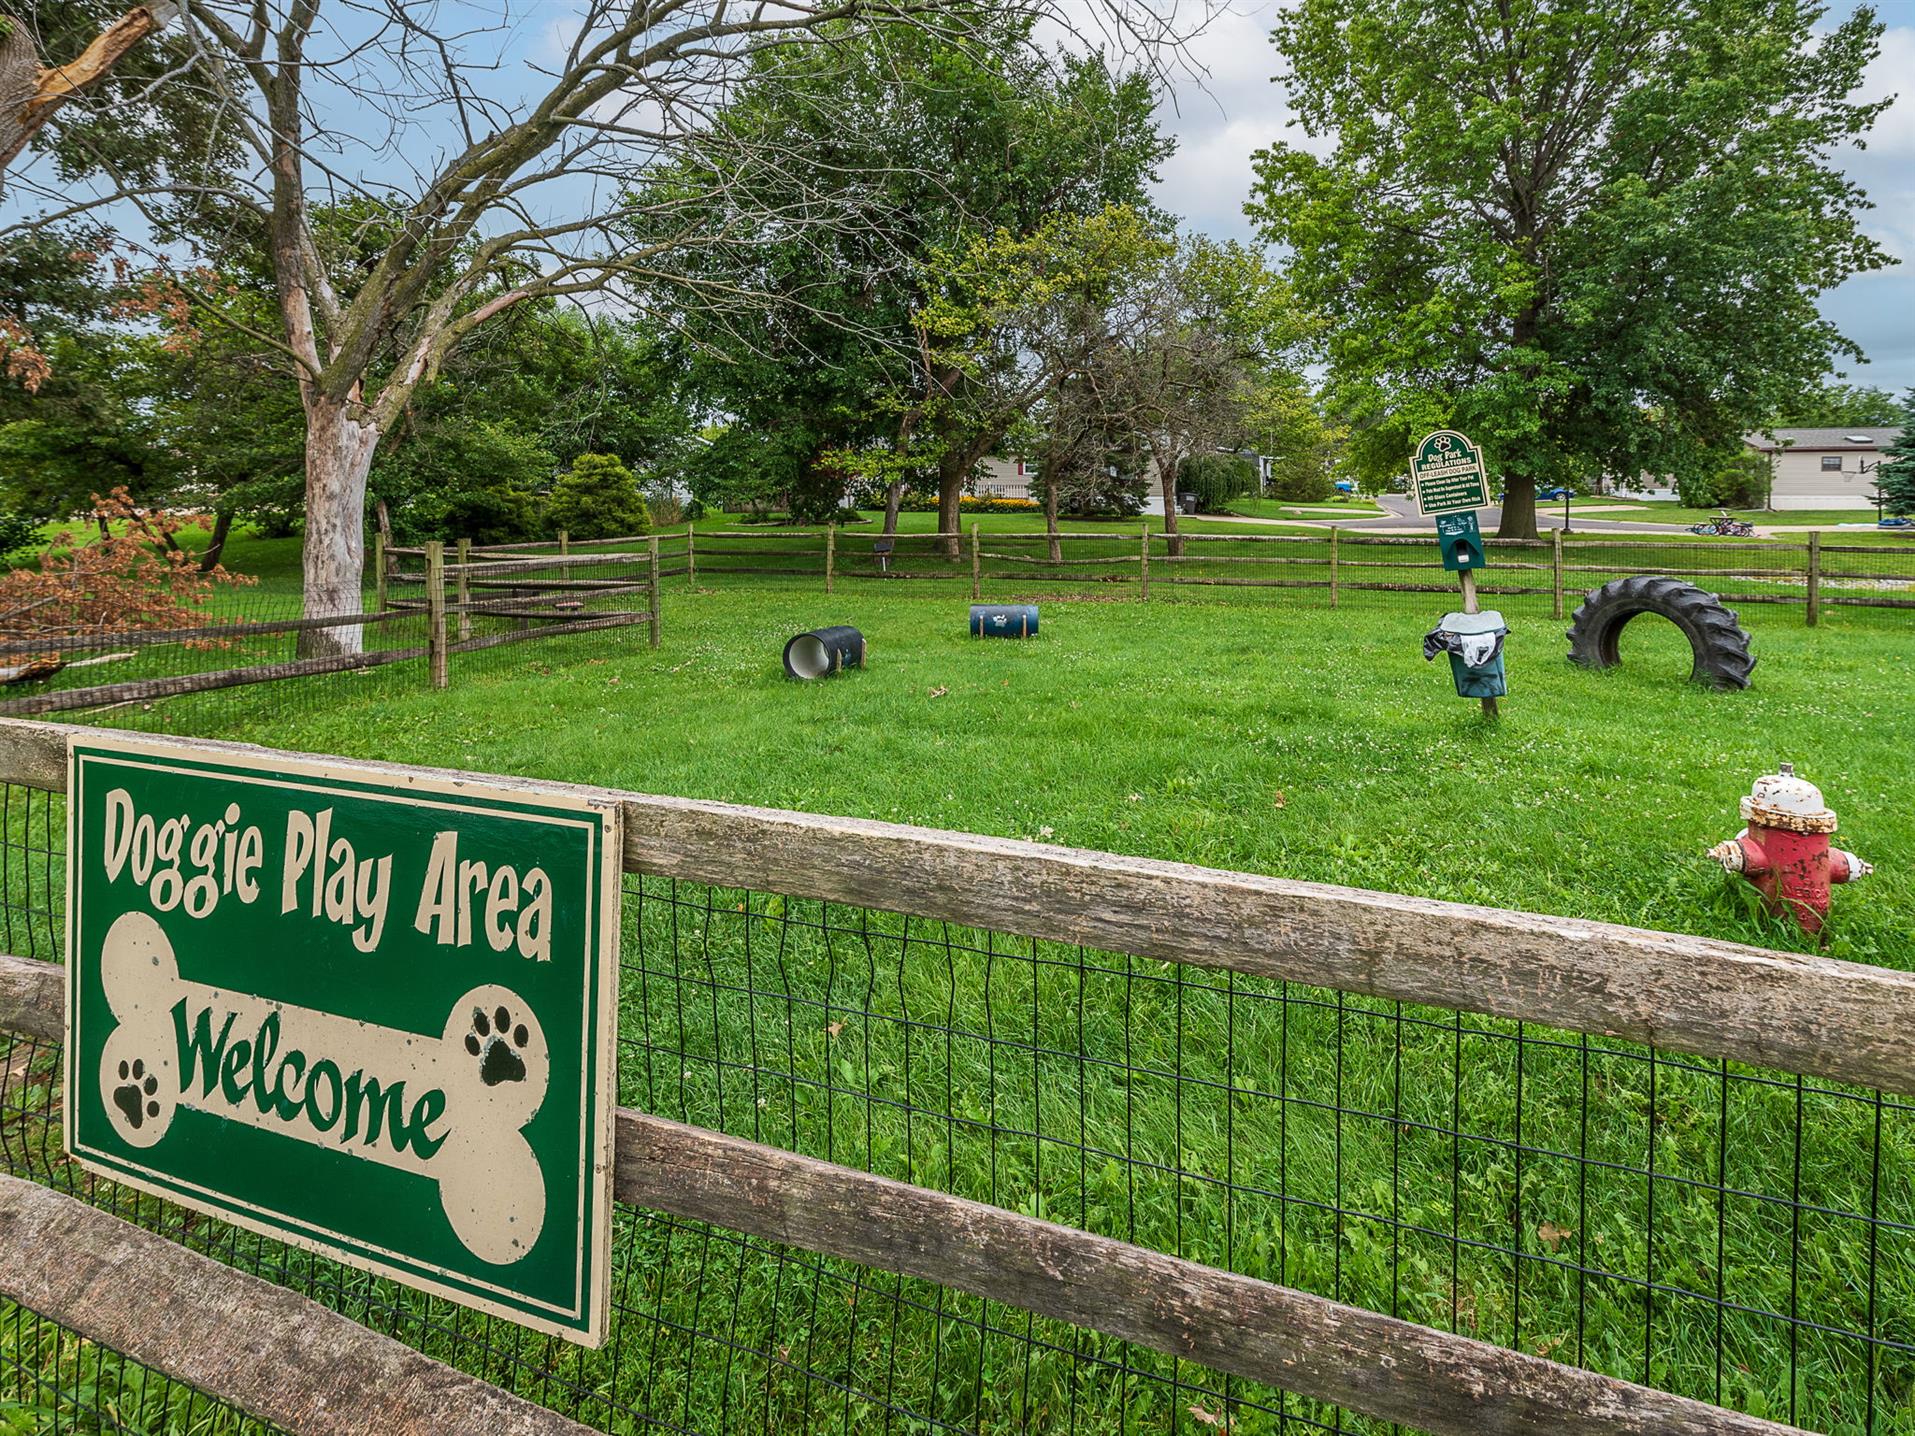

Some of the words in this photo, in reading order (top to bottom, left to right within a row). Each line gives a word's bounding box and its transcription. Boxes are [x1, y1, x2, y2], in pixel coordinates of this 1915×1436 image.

[1428, 453, 1443, 463] Dog
[1444, 448, 1462, 460] Park
[1421, 457, 1471, 470] REGULATIONS
[1420, 470, 1448, 479] OFF-LEASH
[1449, 467, 1461, 475] DOG
[1461, 465, 1477, 473] PARK
[104, 788, 263, 919] Doggie
[281, 807, 393, 953] Play
[414, 830, 553, 962] Area
[170, 997, 451, 1160] Welcome
